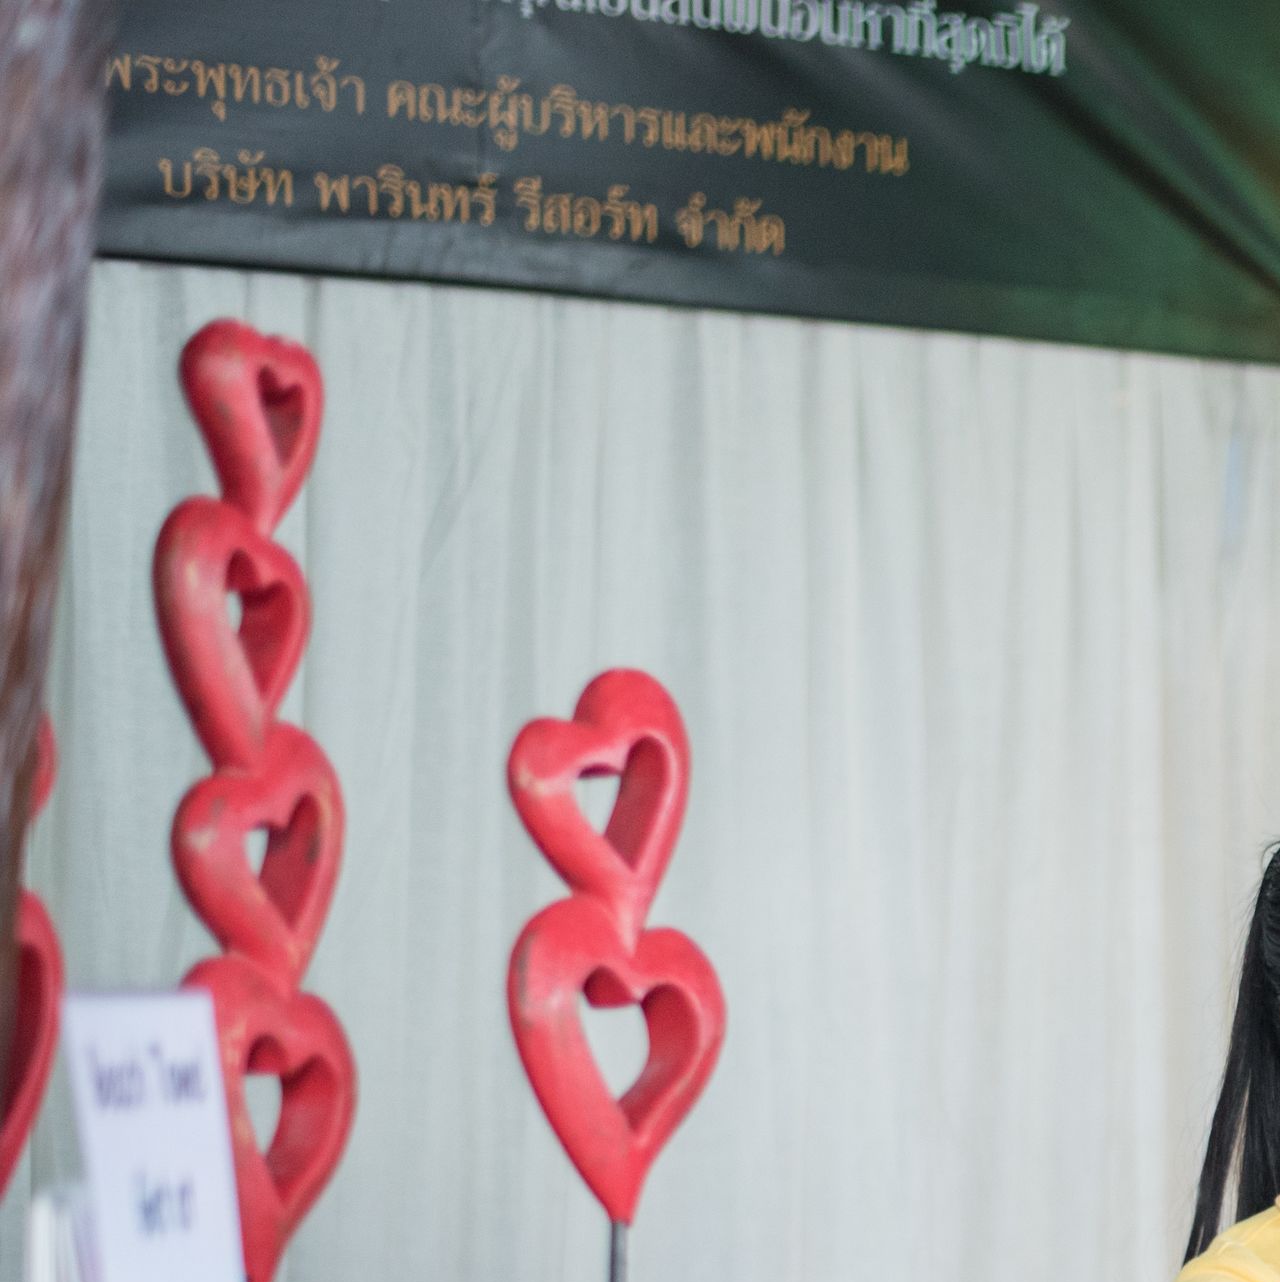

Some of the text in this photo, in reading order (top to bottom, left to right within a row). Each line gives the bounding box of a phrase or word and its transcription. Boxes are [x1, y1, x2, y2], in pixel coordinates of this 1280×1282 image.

[157, 146, 787, 257] บริษัท พารินทร์ รีสอร์ท จำกัด
